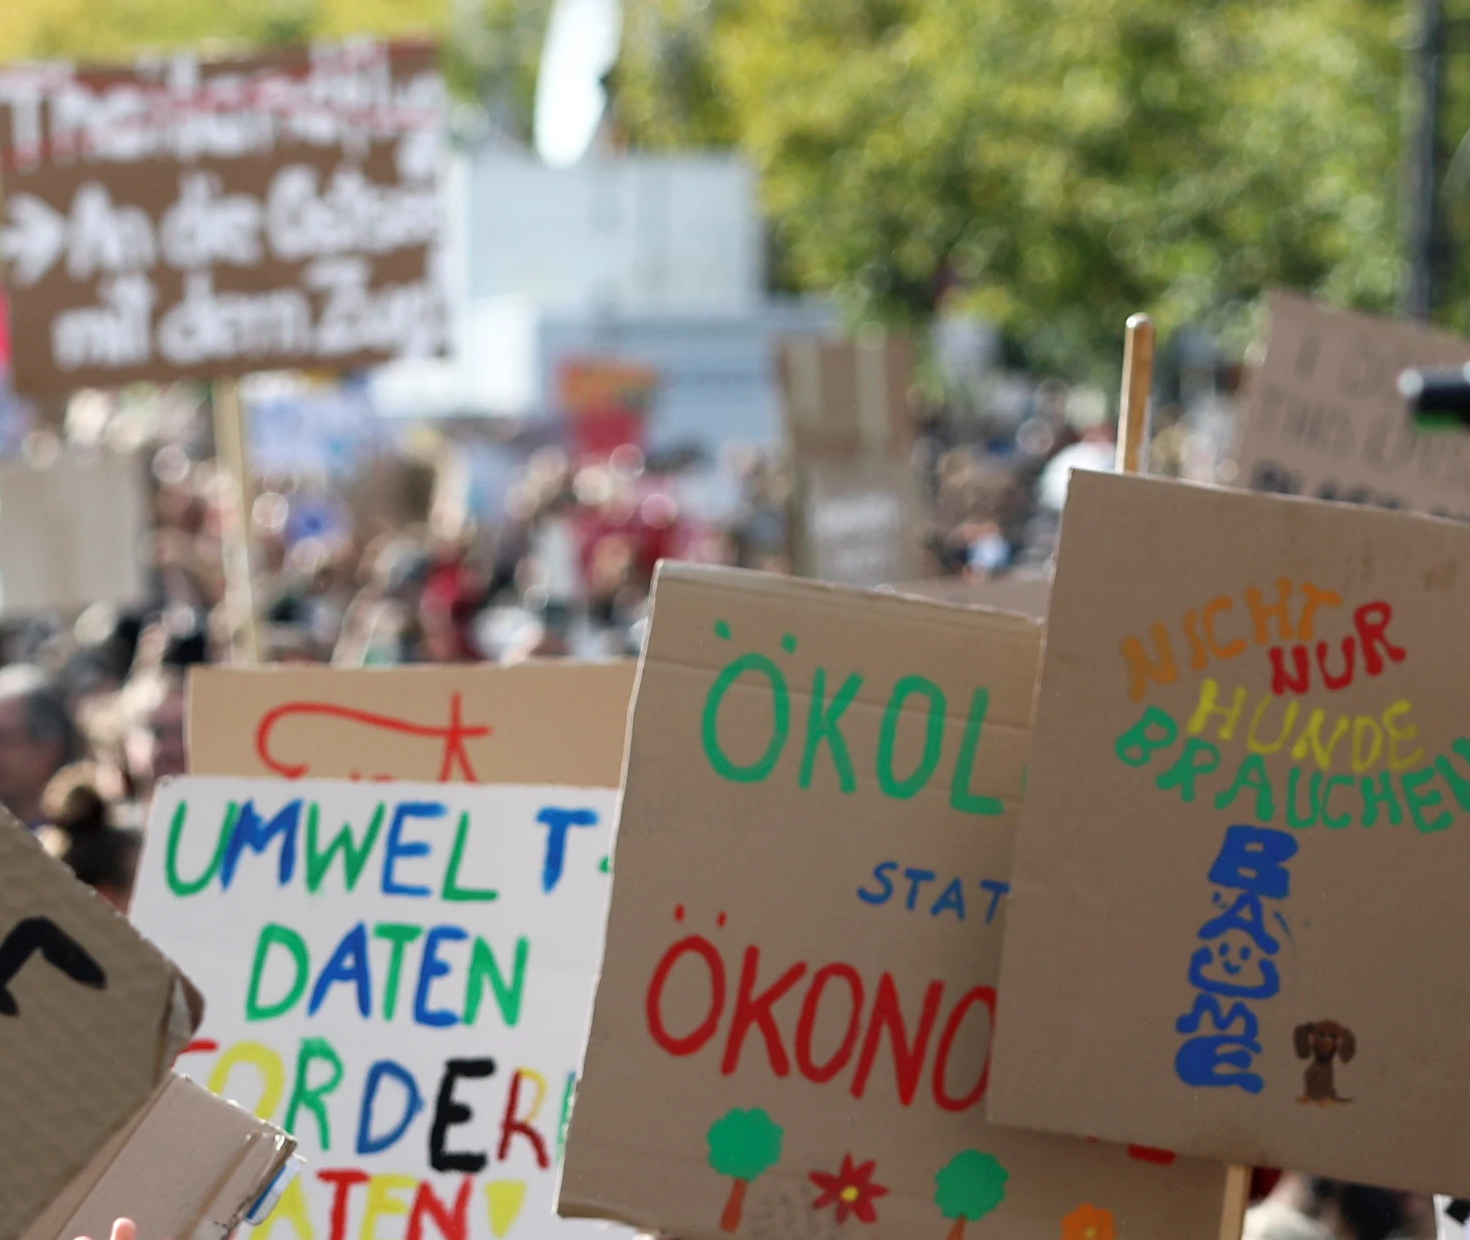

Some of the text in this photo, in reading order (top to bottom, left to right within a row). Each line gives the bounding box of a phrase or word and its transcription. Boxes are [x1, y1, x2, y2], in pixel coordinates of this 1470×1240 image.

[1120, 577, 1342, 702] NICHT
[1269, 600, 1407, 695] NUR
[701, 618, 1028, 816] ÖKOL
[1186, 677, 1426, 773] HUNDE
[245, 921, 530, 1028] DATEN
[181, 1036, 577, 1173] ORDER
